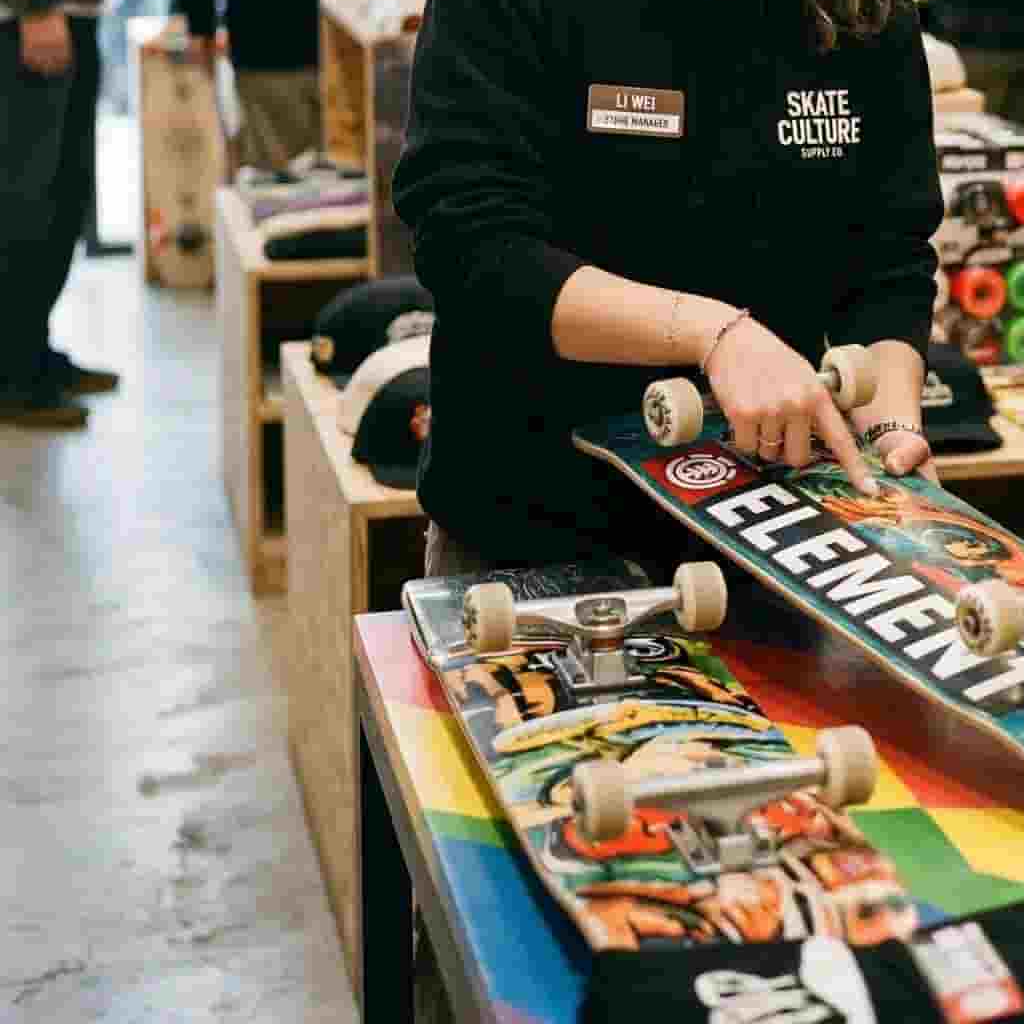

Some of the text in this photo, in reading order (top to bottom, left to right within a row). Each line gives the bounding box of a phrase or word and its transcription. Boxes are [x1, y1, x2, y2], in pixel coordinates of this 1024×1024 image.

[631, 94, 656, 112] WEI
[785, 89, 850, 117] SKATE
[777, 115, 861, 145] CULTURE
